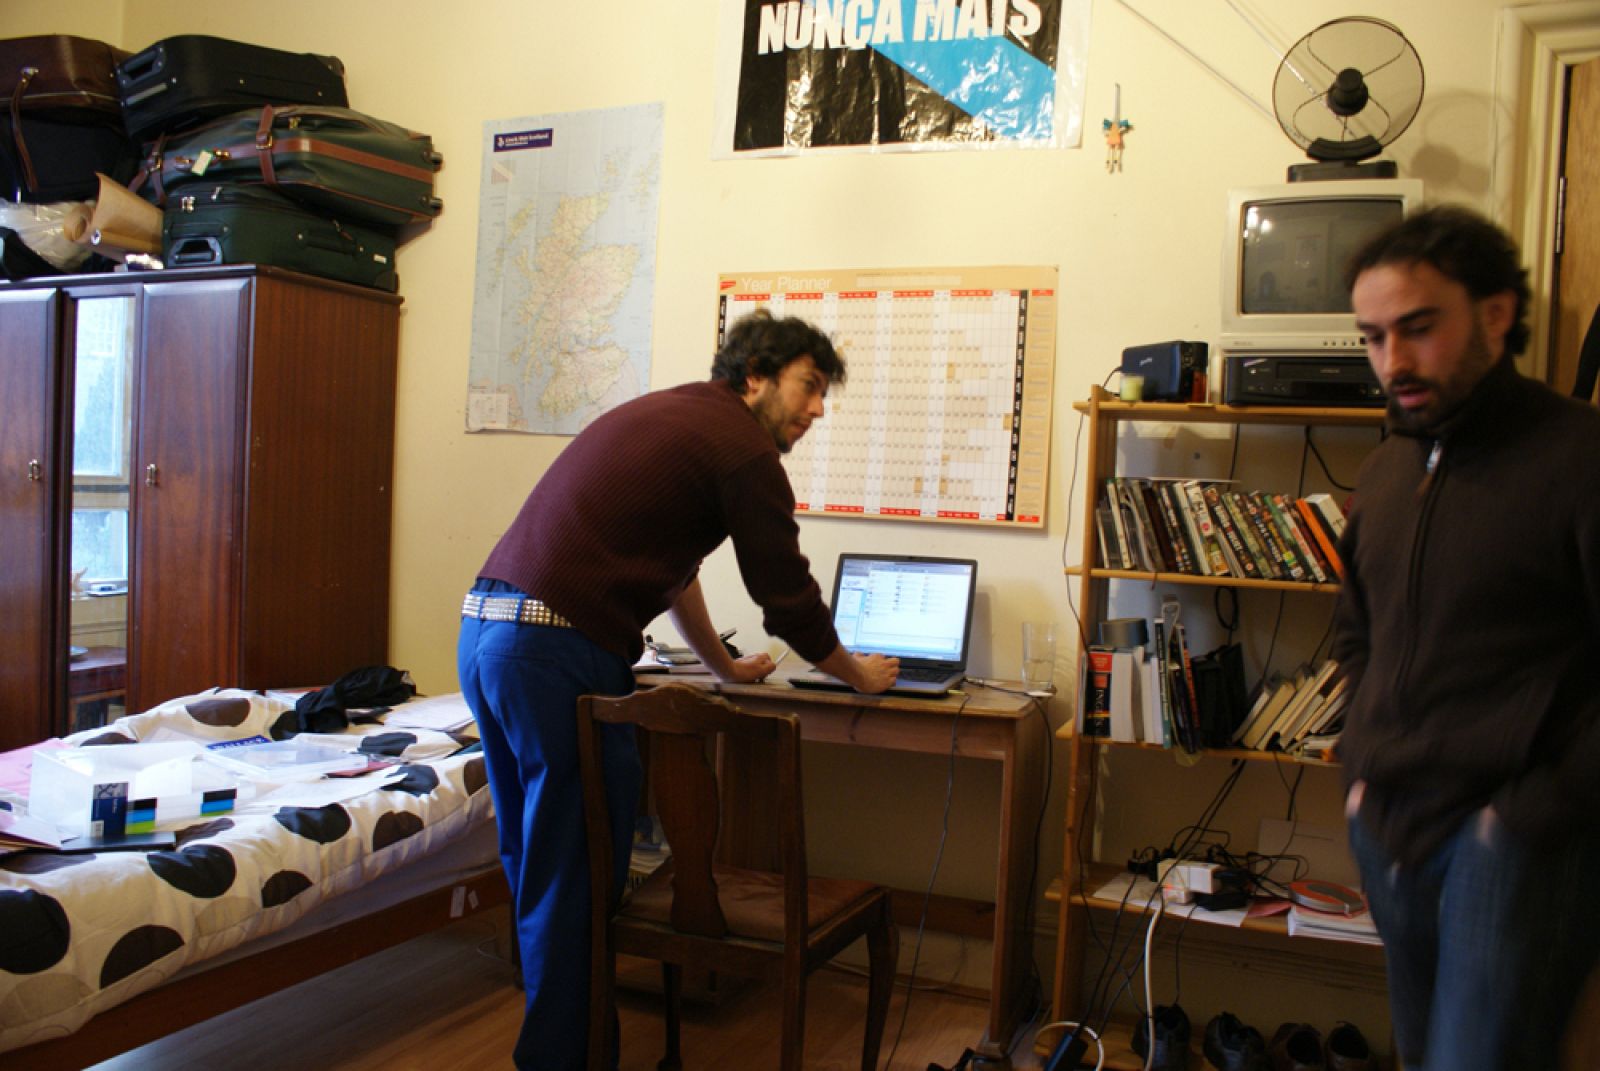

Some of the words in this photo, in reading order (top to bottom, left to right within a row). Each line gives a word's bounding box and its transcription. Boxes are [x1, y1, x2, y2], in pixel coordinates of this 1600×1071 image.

[758, 0, 904, 55] NUNCA
[913, 0, 1042, 42] MAIS
[741, 277, 773, 292] Year
[778, 275, 832, 291] Planner
